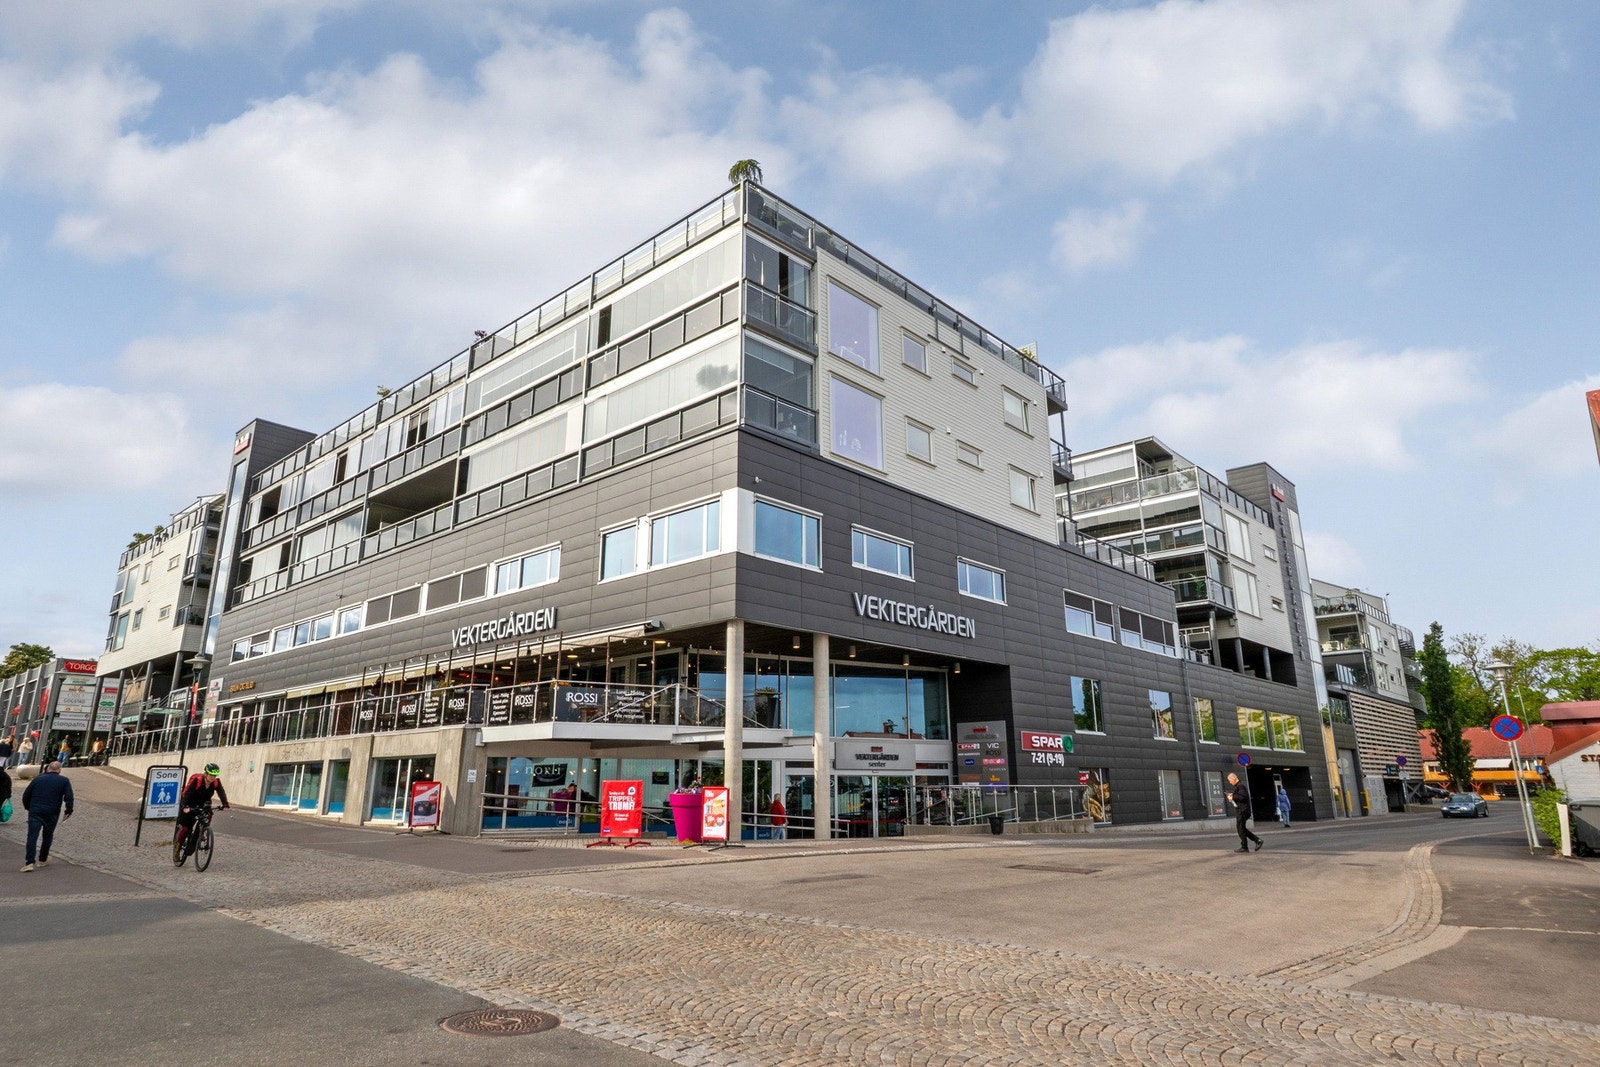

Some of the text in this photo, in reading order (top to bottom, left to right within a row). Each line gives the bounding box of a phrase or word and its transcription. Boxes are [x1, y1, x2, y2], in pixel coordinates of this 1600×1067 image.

[854, 591, 975, 639] VEKTERGÅRDEN
[451, 606, 556, 648] VEKTERGÅRDEN
[449, 698, 465, 708] ROSSI
[515, 694, 534, 706] ROSSI
[565, 692, 598, 703] ROSSI
[402, 704, 416, 714] ROSSI
[360, 710, 374, 720] ROSSI
[1031, 735, 1063, 749] SPAR
[855, 753, 899, 761] VEKTERGÅRDEN
[1031, 752, 1064, 767] 7-21 (9-19)
[156, 771, 178, 779] Sone
